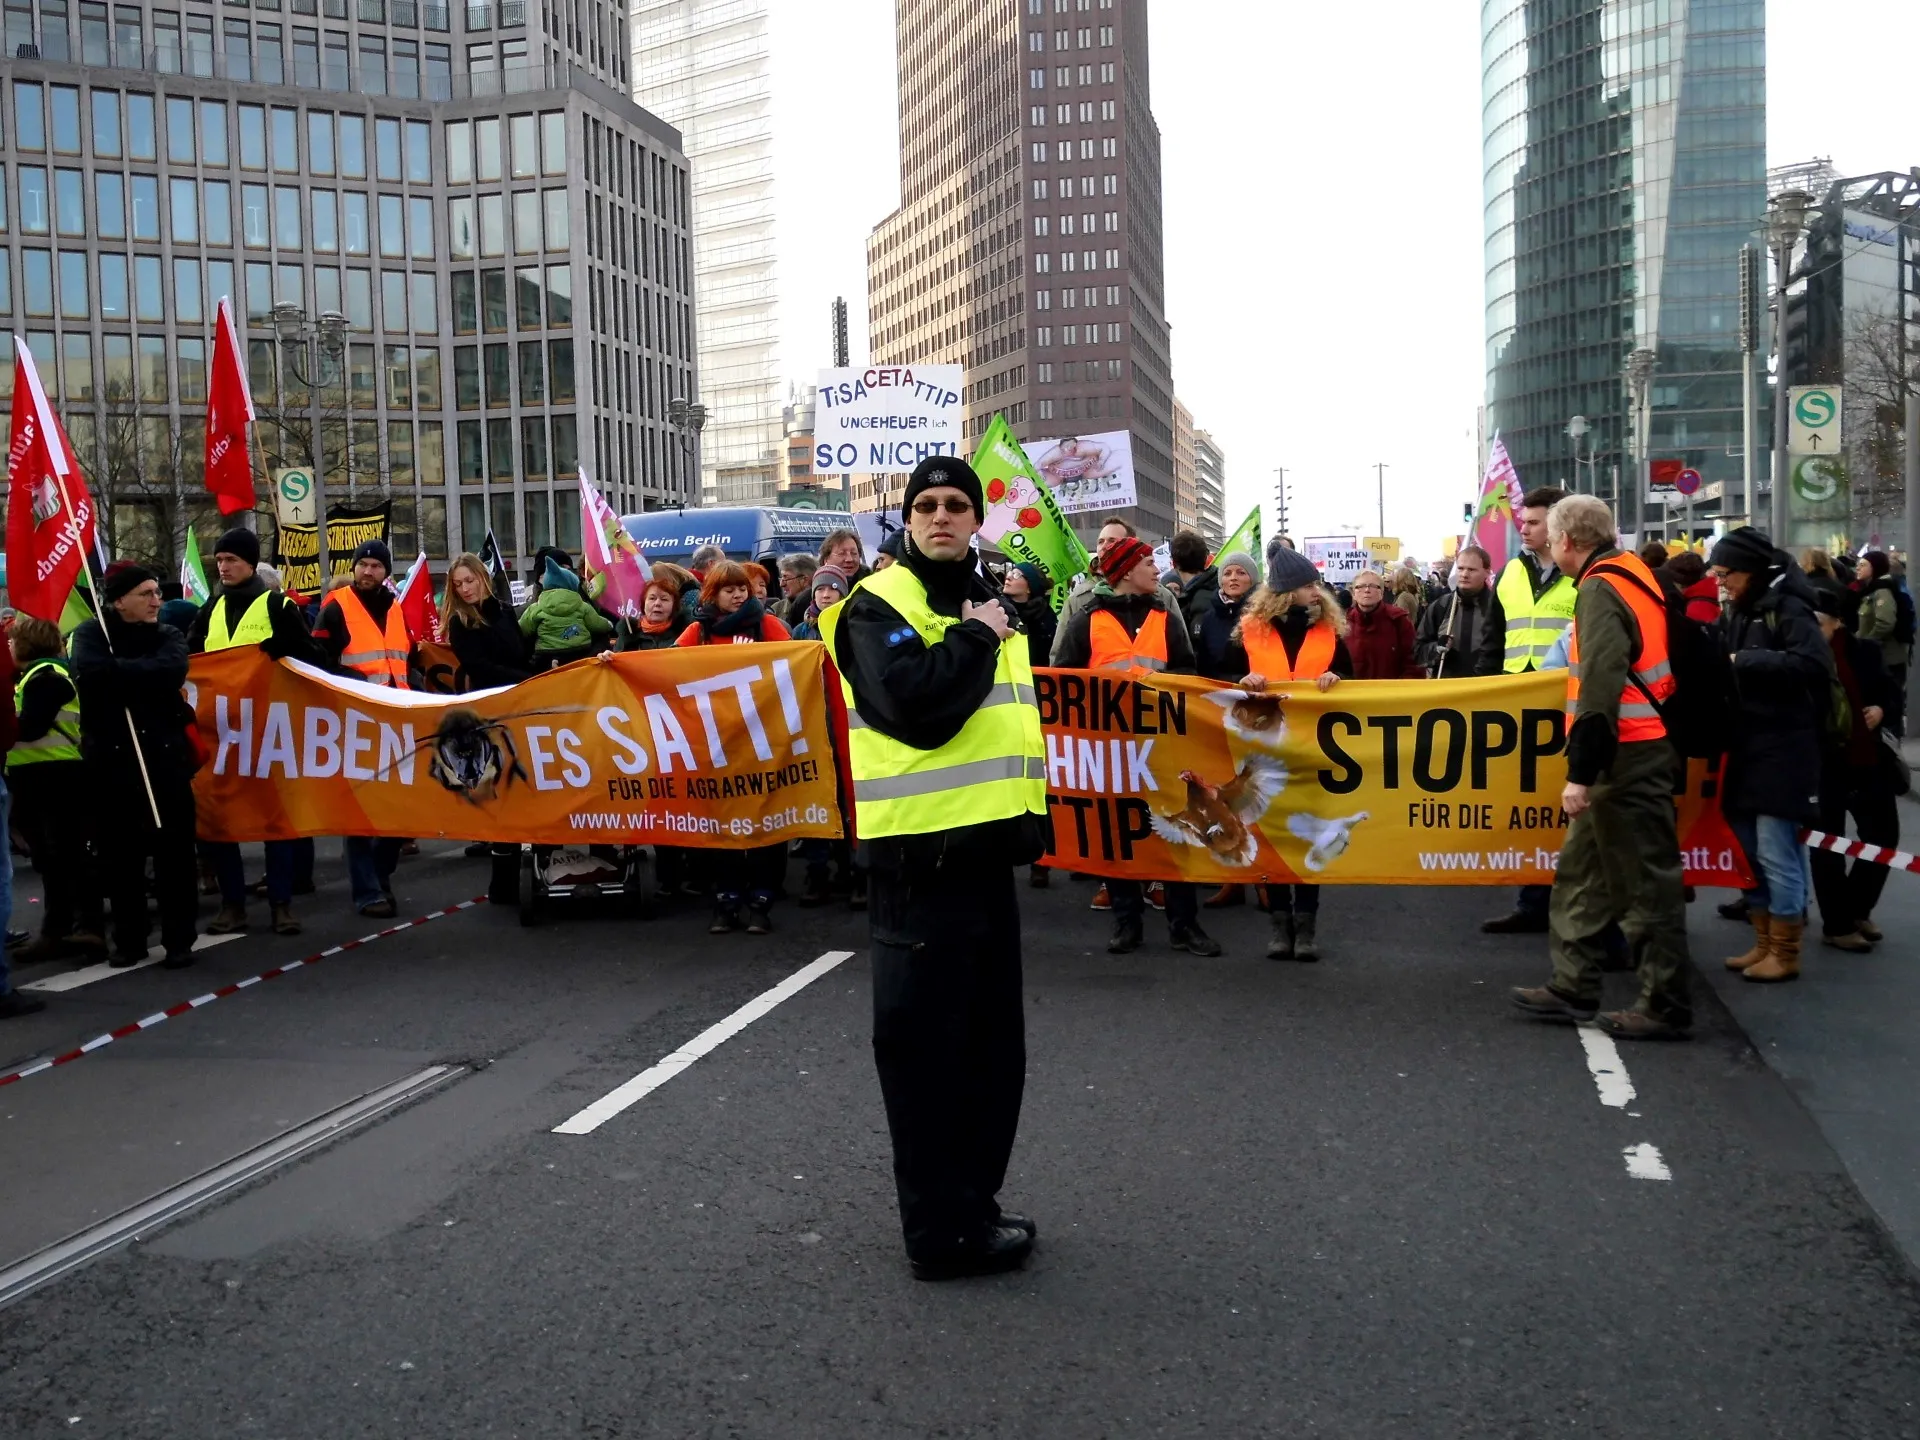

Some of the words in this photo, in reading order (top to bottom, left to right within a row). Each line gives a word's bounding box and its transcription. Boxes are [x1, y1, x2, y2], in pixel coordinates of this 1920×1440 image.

[863, 368, 915, 389] CETA
[914, 380, 959, 408] TTIP
[840, 415, 928, 430] UNGEHEUER
[816, 443, 858, 469] SO
[870, 441, 957, 466] NICHT!
[993, 442, 1025, 470] NEIN
[635, 536, 679, 549] rheim
[684, 534, 731, 547] Berlin
[1327, 551, 1341, 559] WIR
[1345, 551, 1368, 559] HABEN
[1371, 542, 1391, 550] Fürth
[1018, 544, 1050, 574] BUND
[1338, 560, 1367, 570] SATT!
[1034, 674, 1187, 736] BRIKEN
[213, 694, 416, 785] HABEN
[525, 726, 591, 791] ES
[596, 658, 810, 775] SATT!
[1045, 734, 1160, 794] HNIK
[608, 777, 643, 801] FÜR
[649, 776, 676, 800] DIE
[686, 759, 820, 799] AGRARWENDE!
[569, 803, 829, 835] www.wir-haben-es-satt.de
[1408, 798, 1451, 829] FÜR
[1458, 804, 1494, 830] DIE
[1508, 805, 1570, 830] AGRA
